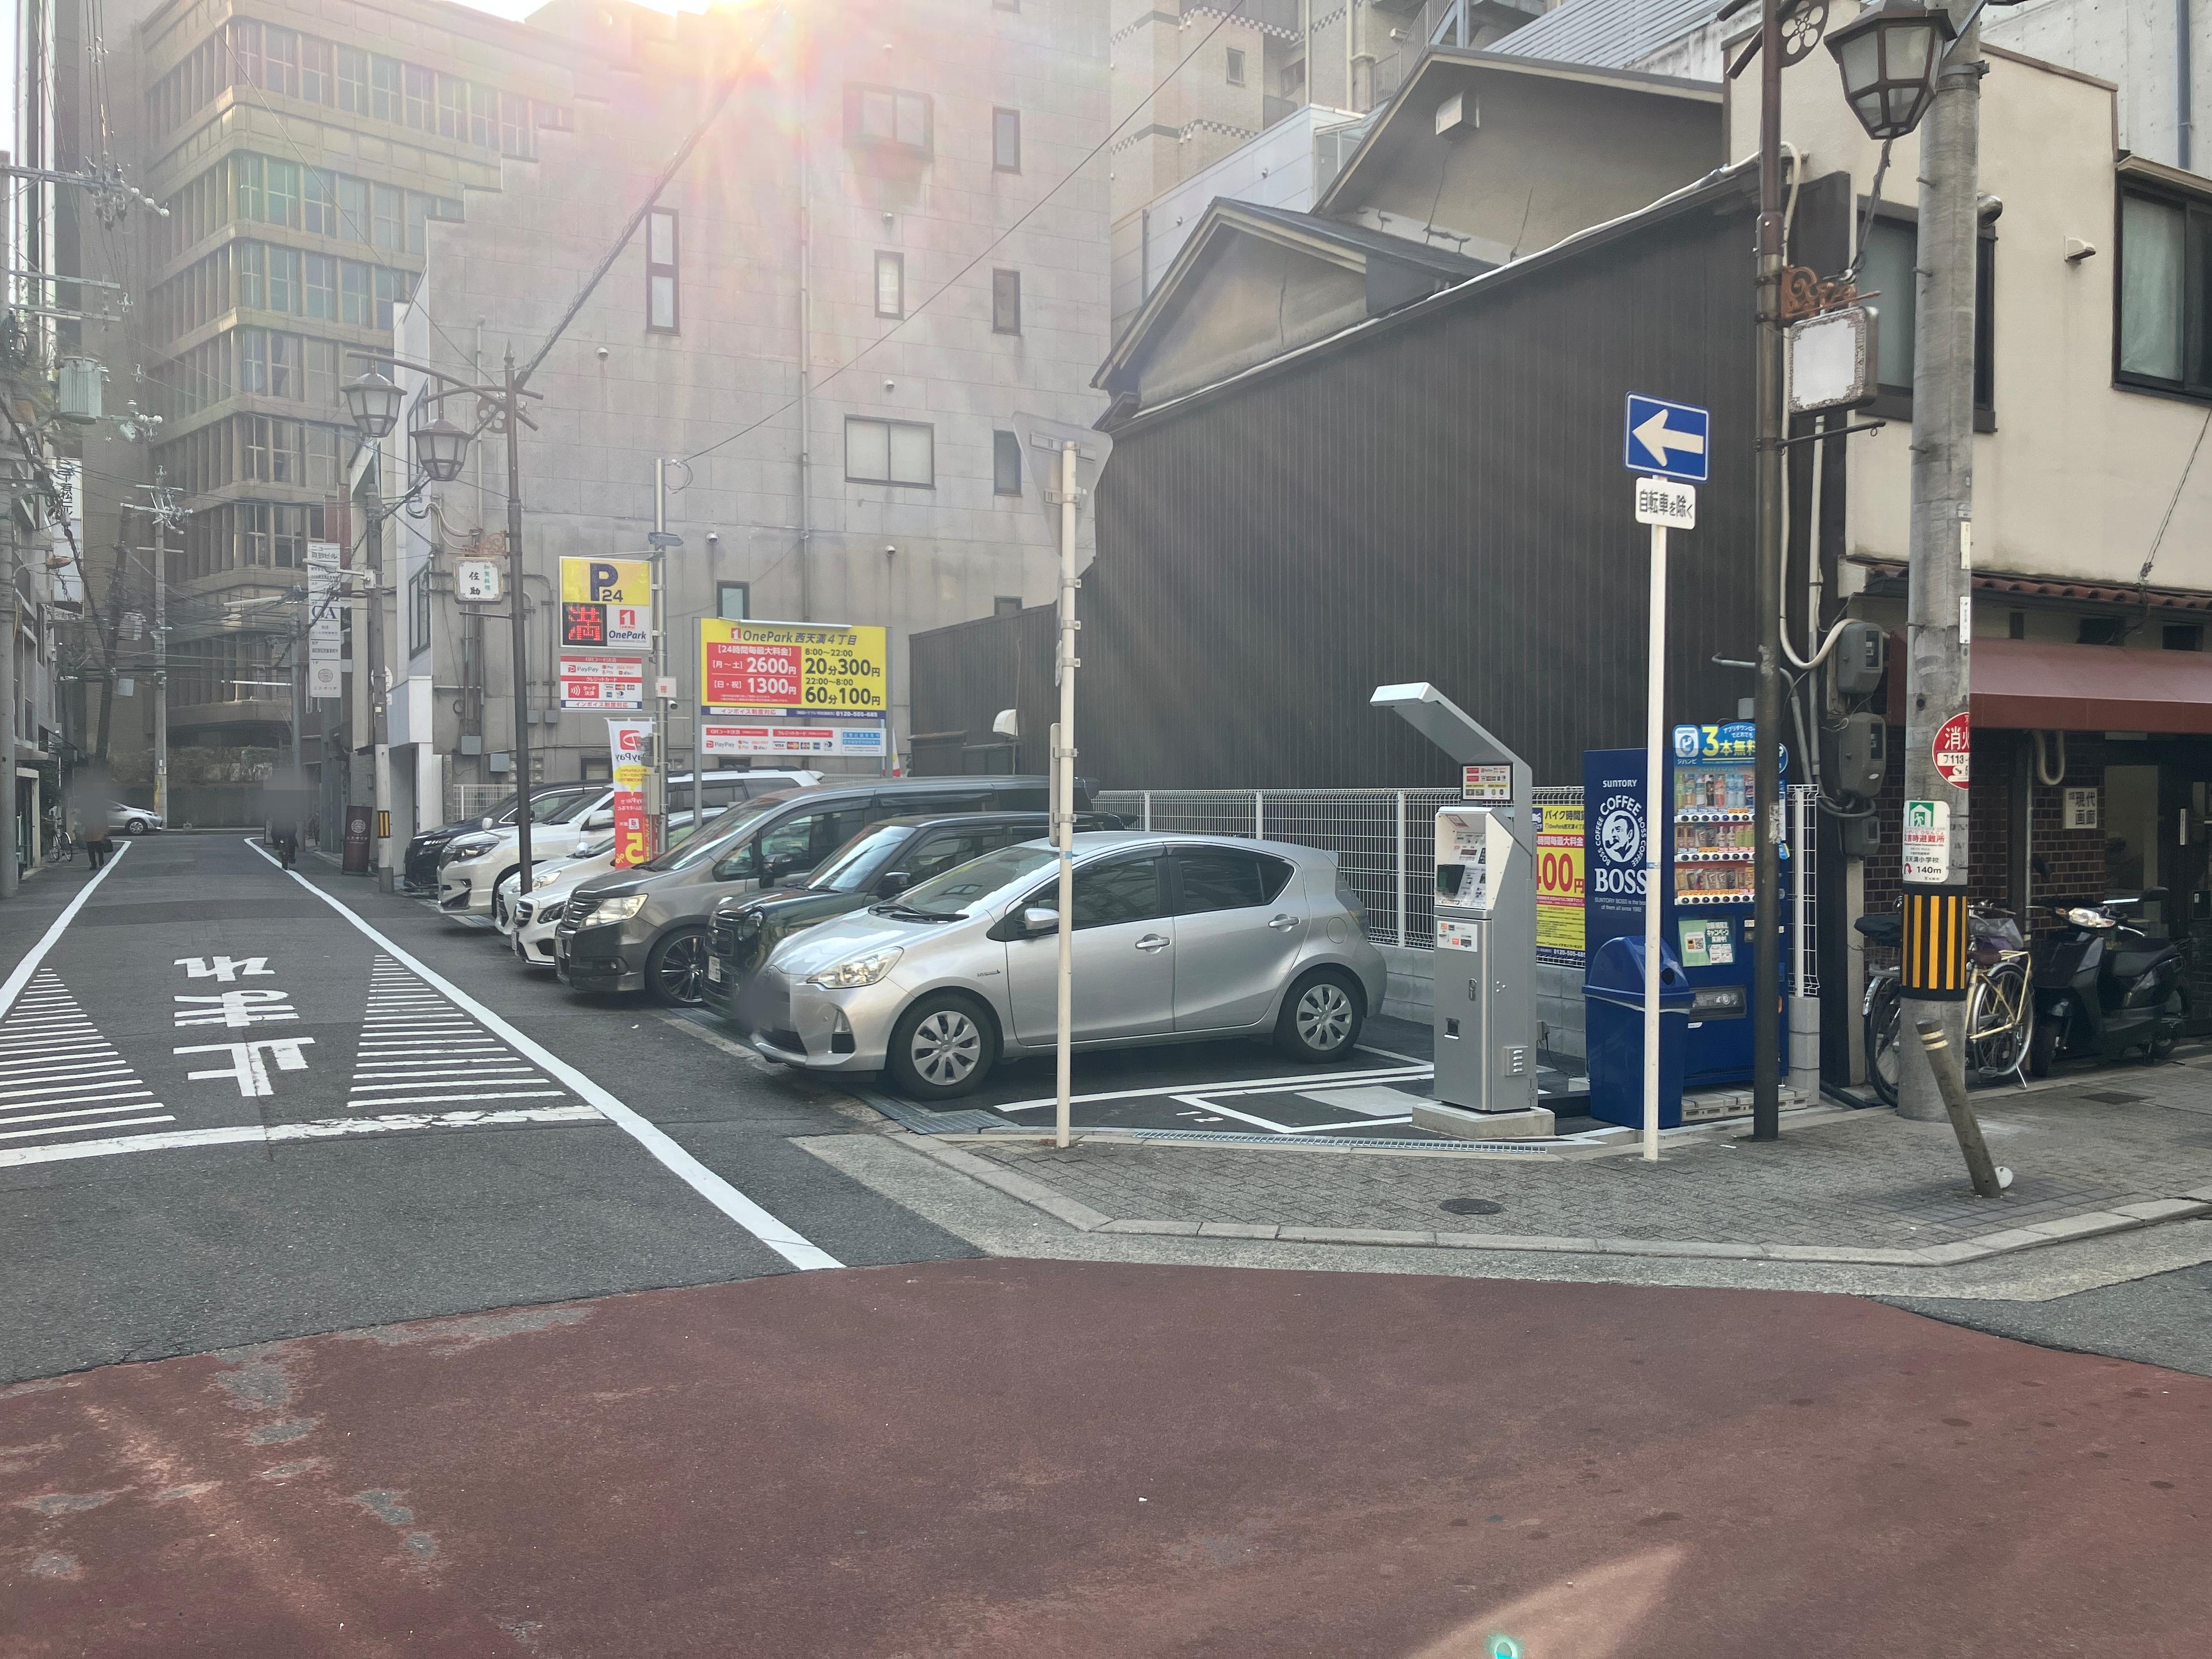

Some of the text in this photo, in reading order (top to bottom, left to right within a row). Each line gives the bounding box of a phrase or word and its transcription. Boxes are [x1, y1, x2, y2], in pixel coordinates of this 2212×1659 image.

[1639, 490, 1693, 519] 自転車を除く
[469, 571, 480, 596] 佐助
[590, 563, 618, 601] P
[602, 589, 623, 602] 24
[608, 630, 647, 639] OnePark
[743, 630, 793, 643] OnePark
[795, 633, 857, 646] 西天満4丁目
[747, 657, 797, 675] 2600円
[805, 658, 881, 677] 20分300円
[747, 677, 797, 695] 1300円
[805, 687, 881, 706] 60分100円
[1603, 779, 1638, 788] SUNTORY
[1600, 795, 1642, 816] COFFEE
[1537, 836, 1584, 847] 時間毎最大料金
[1594, 816, 1611, 866] BOSS COFFEE
[1631, 816, 1646, 867] BOSS COFFEE
[1916, 866, 1942, 874] 140m
[1594, 868, 1647, 895] BOSS
